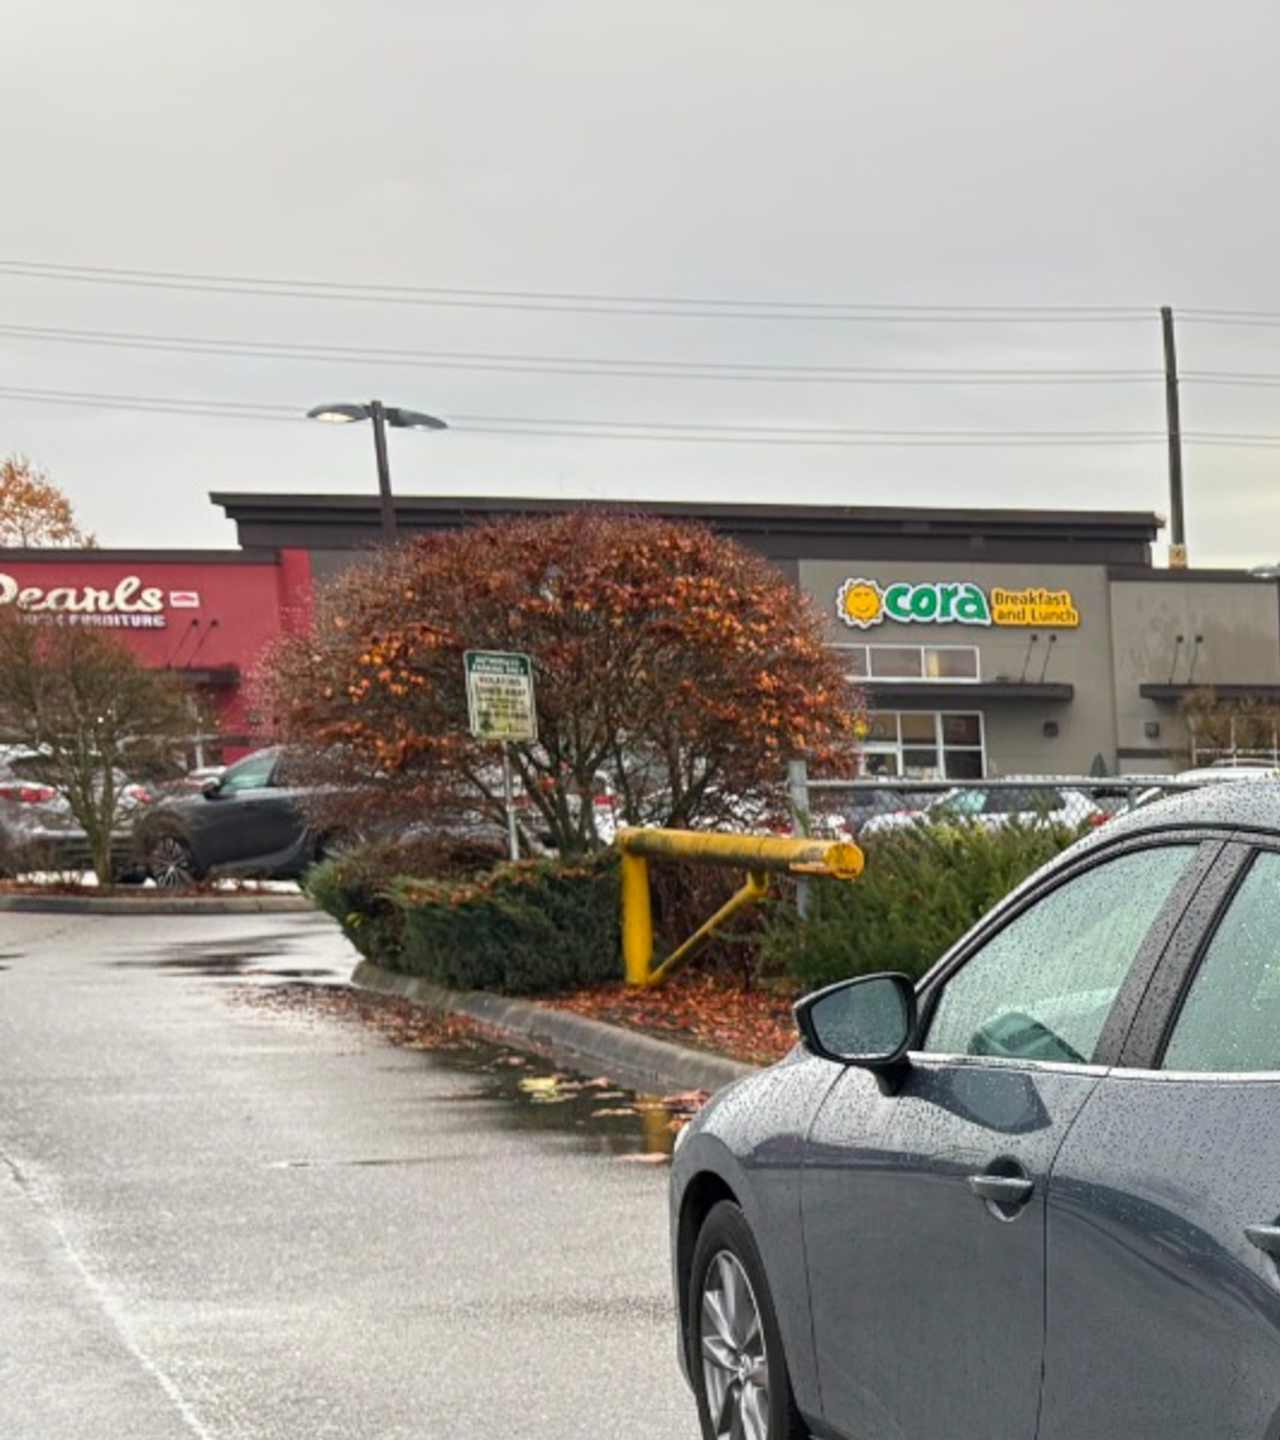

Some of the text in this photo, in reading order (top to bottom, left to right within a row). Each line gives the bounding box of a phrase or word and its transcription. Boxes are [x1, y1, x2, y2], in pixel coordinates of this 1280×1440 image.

[884, 583, 990, 621] cora
[995, 591, 1067, 606] Breakfast
[69, 613, 166, 628] FURNITURE
[997, 607, 1076, 623] and Lunch
